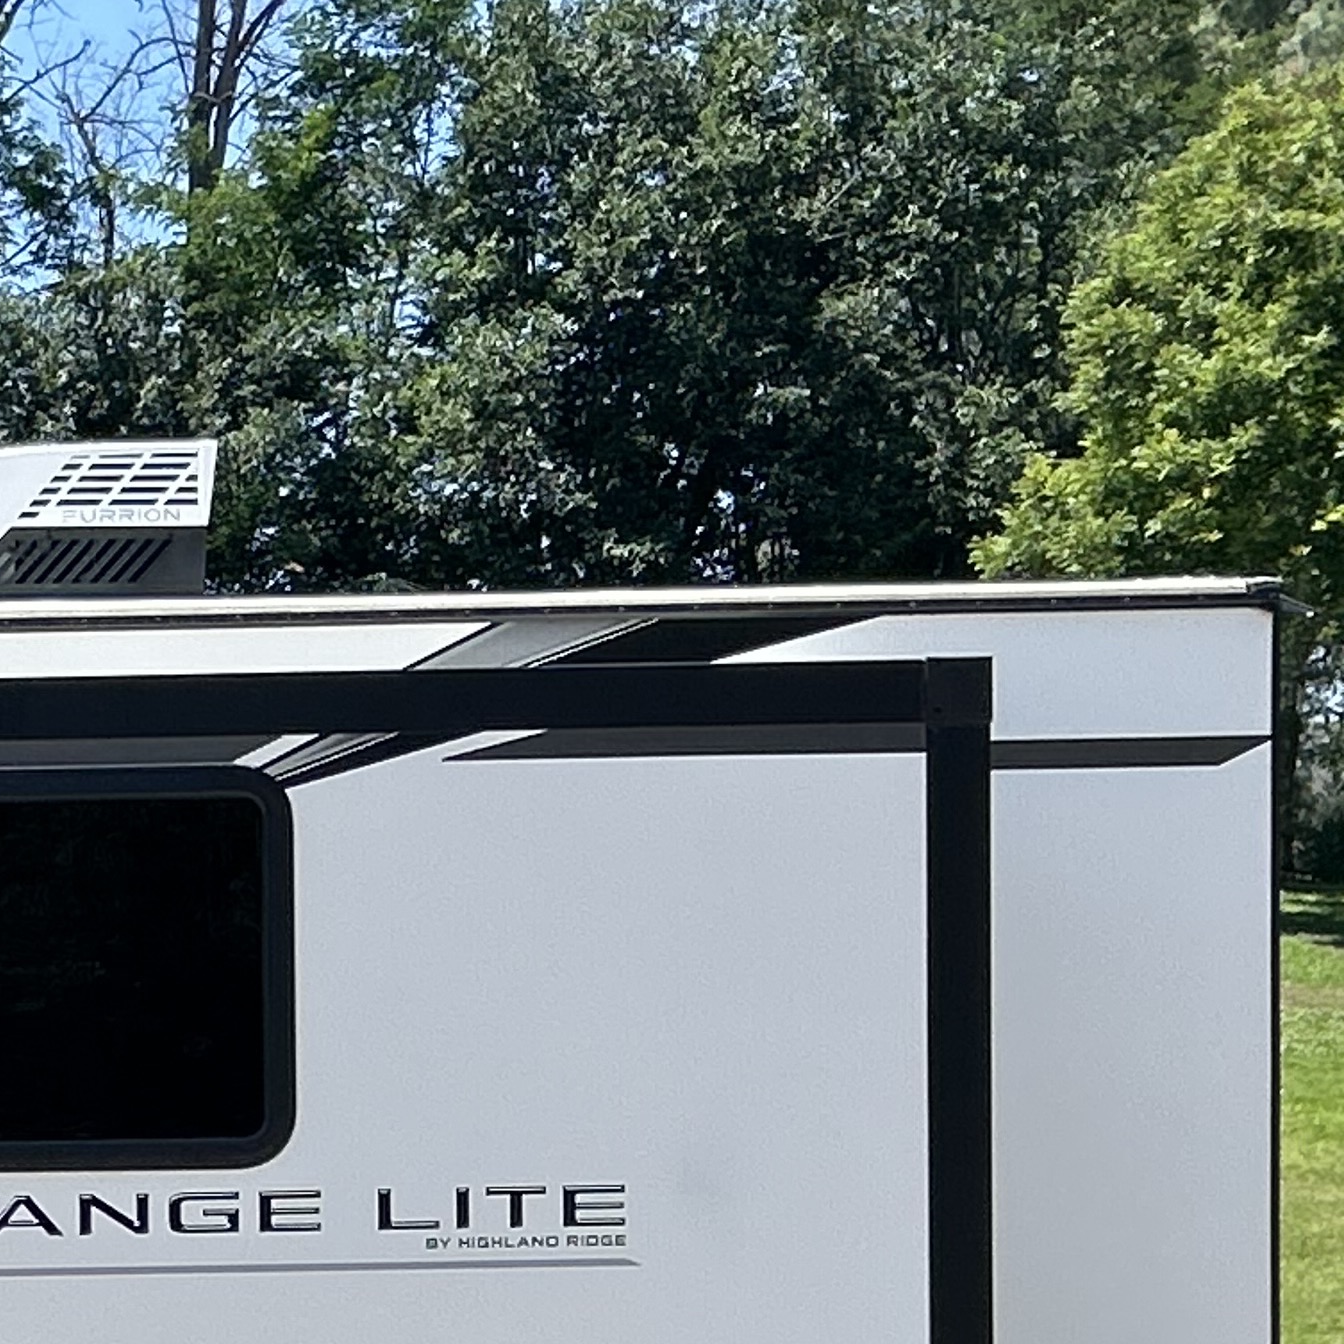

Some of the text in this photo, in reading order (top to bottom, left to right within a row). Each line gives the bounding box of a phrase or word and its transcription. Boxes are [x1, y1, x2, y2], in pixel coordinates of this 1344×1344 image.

[62, 508, 181, 523] FURRION
[377, 1184, 625, 1230] LITE
[425, 1234, 627, 1250] BY HIGHLAND RIDGE
